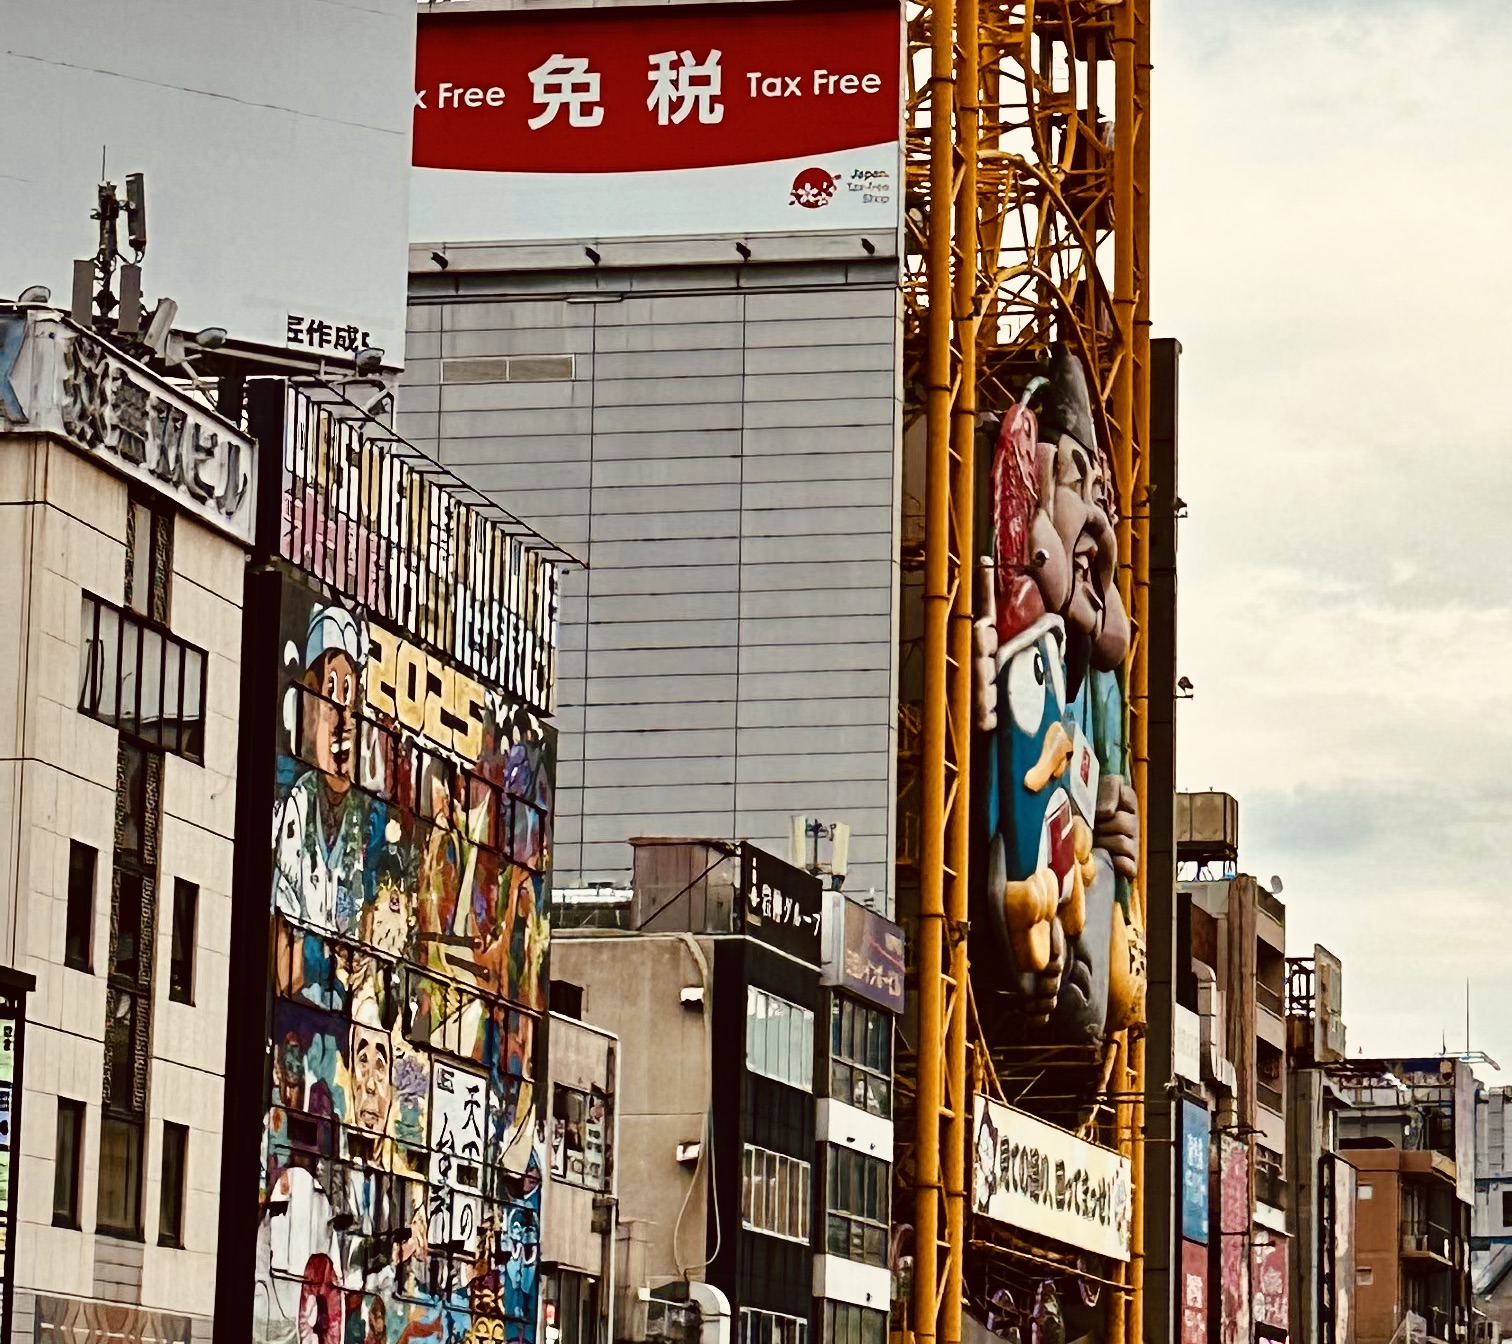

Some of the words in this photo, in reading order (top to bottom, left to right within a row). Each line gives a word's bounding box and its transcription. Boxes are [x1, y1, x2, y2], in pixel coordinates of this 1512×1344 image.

[438, 82, 506, 109] Free
[745, 71, 803, 98] Tax
[813, 69, 883, 96] Free
[361, 621, 487, 764] 2025
